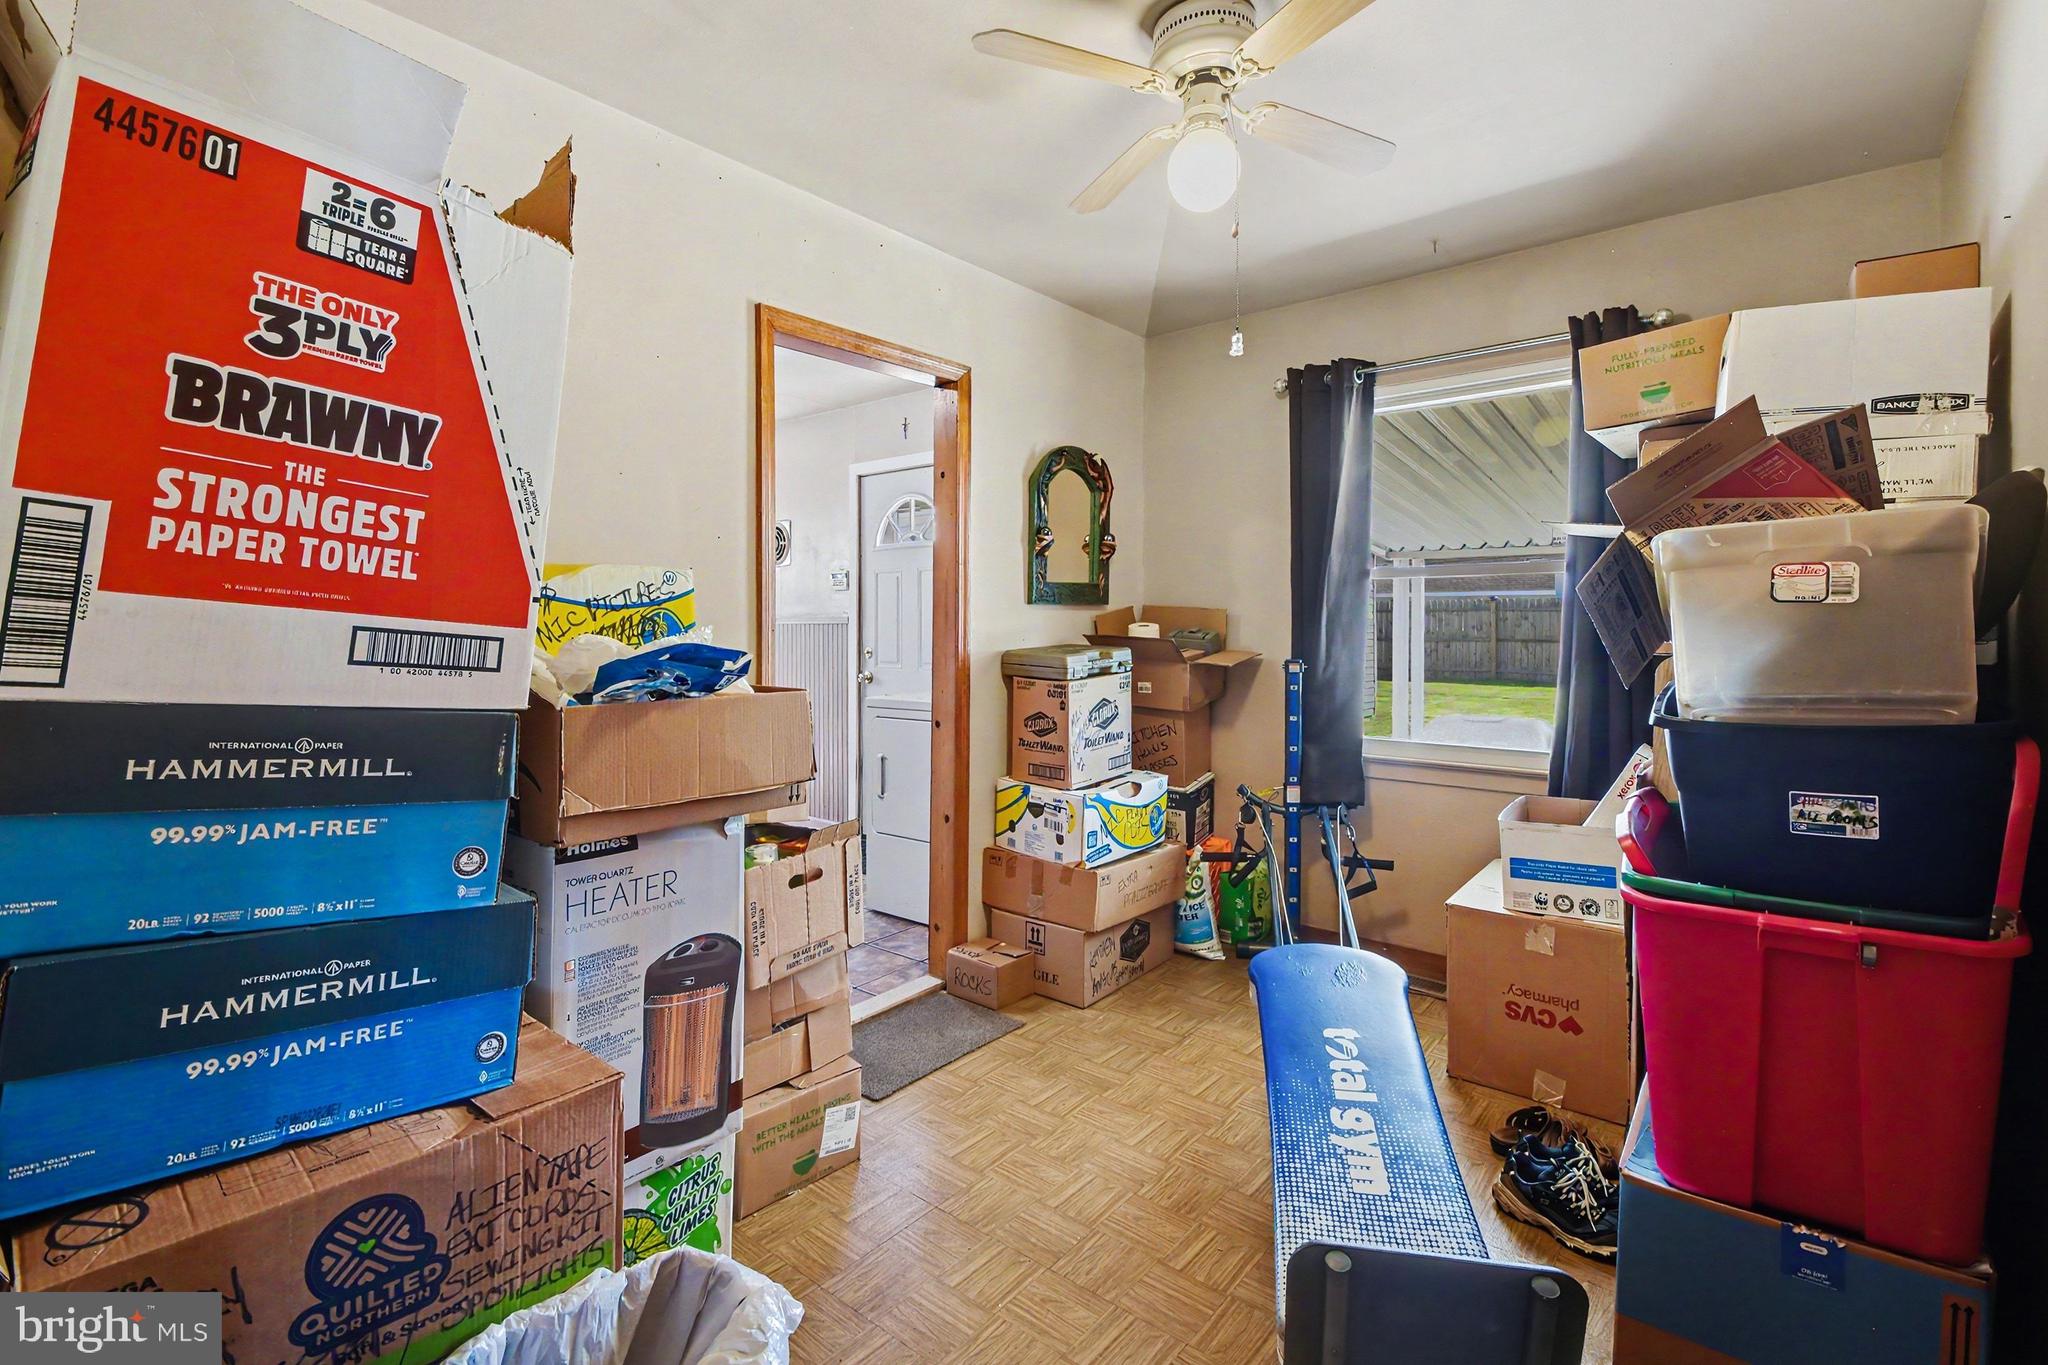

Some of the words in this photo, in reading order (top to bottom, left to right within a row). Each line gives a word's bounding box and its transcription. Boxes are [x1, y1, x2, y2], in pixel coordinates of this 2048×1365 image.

[93, 97, 198, 161] 44576
[204, 135, 238, 176] 01
[321, 201, 366, 228] TRIPLE
[346, 250, 405, 279] SQUARE
[363, 240, 397, 262] TEAR
[399, 253, 406, 265] A
[258, 275, 316, 308] THE
[321, 296, 394, 330] ONLY
[248, 297, 393, 361] 3PLY
[1670, 345, 1705, 360] MEALS
[172, 359, 438, 467] BRAWNY
[285, 461, 326, 487] THE
[1904, 478, 1934, 487] WE'LL
[153, 467, 425, 544] STRONGEST
[147, 516, 286, 565] PAPER
[299, 536, 418, 581] TOWEL
[77, 574, 93, 621] 44576/01
[585, 580, 675, 621] PICTURES
[208, 742, 294, 751] INTERNATIONAL
[314, 742, 344, 751] PAPER
[125, 758, 407, 781] HAMMERMILL
[150, 824, 236, 845] 99.99%
[237, 818, 378, 845] JAM-FREE
[567, 836, 629, 856] Holmes
[565, 874, 598, 888] TOWER
[599, 866, 634, 880] QUARTZ
[566, 869, 678, 922] HEATER
[1188, 902, 1206, 912] ICE
[193, 913, 210, 924] 92
[253, 906, 284, 919] 5000
[241, 967, 324, 985] INTERNATIONAL
[343, 959, 371, 970] PAPER
[954, 966, 993, 995] ROCKS
[160, 967, 431, 1029] HAMMERMILL
[1505, 983, 1580, 1012] pharmacy
[1505, 1001, 1557, 1029] CVS
[186, 1048, 270, 1080] 99.99%
[270, 1020, 404, 1067] JAM-FREE
[1323, 1028, 1378, 1102] total
[288, 1120, 318, 1134] 5000
[230, 1137, 247, 1149] 92
[752, 1138, 777, 1155] WITH
[779, 1129, 796, 1143] THE
[1328, 1106, 1391, 1196] gym
[668, 1156, 719, 1208] CITRUS
[662, 1173, 721, 1232] QUALITY
[671, 1197, 716, 1246] LIMES
[300, 1262, 443, 1336] QUILTED
[316, 1287, 431, 1346] NORTHERN
